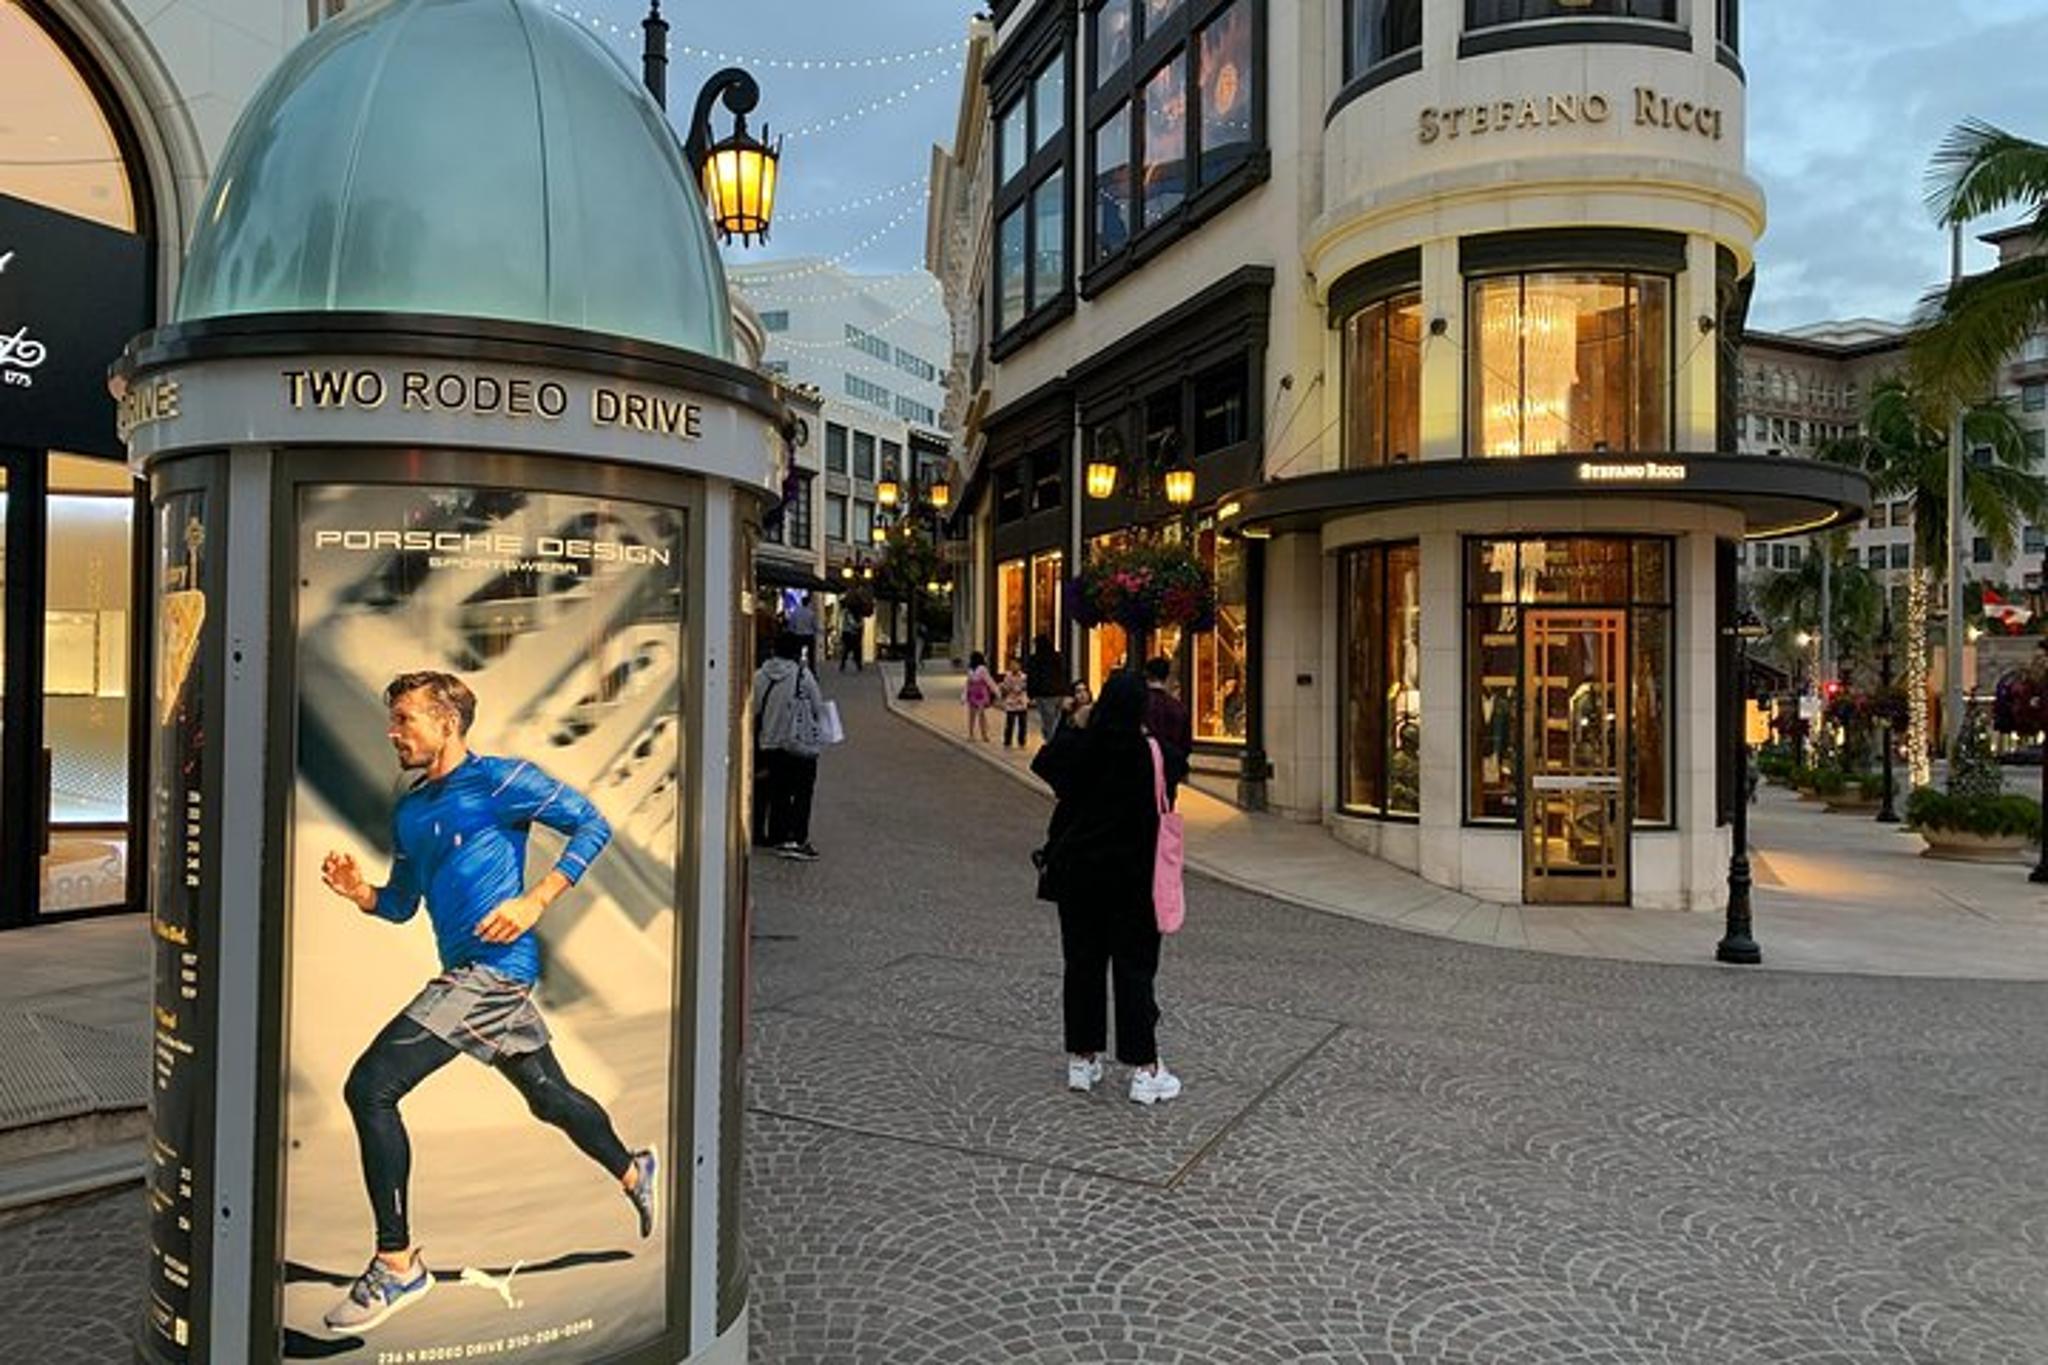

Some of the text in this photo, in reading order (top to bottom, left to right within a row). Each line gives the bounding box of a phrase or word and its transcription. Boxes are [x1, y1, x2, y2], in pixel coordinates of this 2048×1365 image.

[1417, 87, 1723, 144] STEFANO RICCI
[283, 371, 702, 440] TWO RODEO DRIVE
[1580, 463, 1686, 479] STEFANO RICCI
[315, 531, 670, 567] PORSCHE DESIGN
[406, 1350, 418, 1363] N
[419, 1346, 464, 1361] RODEO
[466, 1338, 505, 1357] DRIVE
